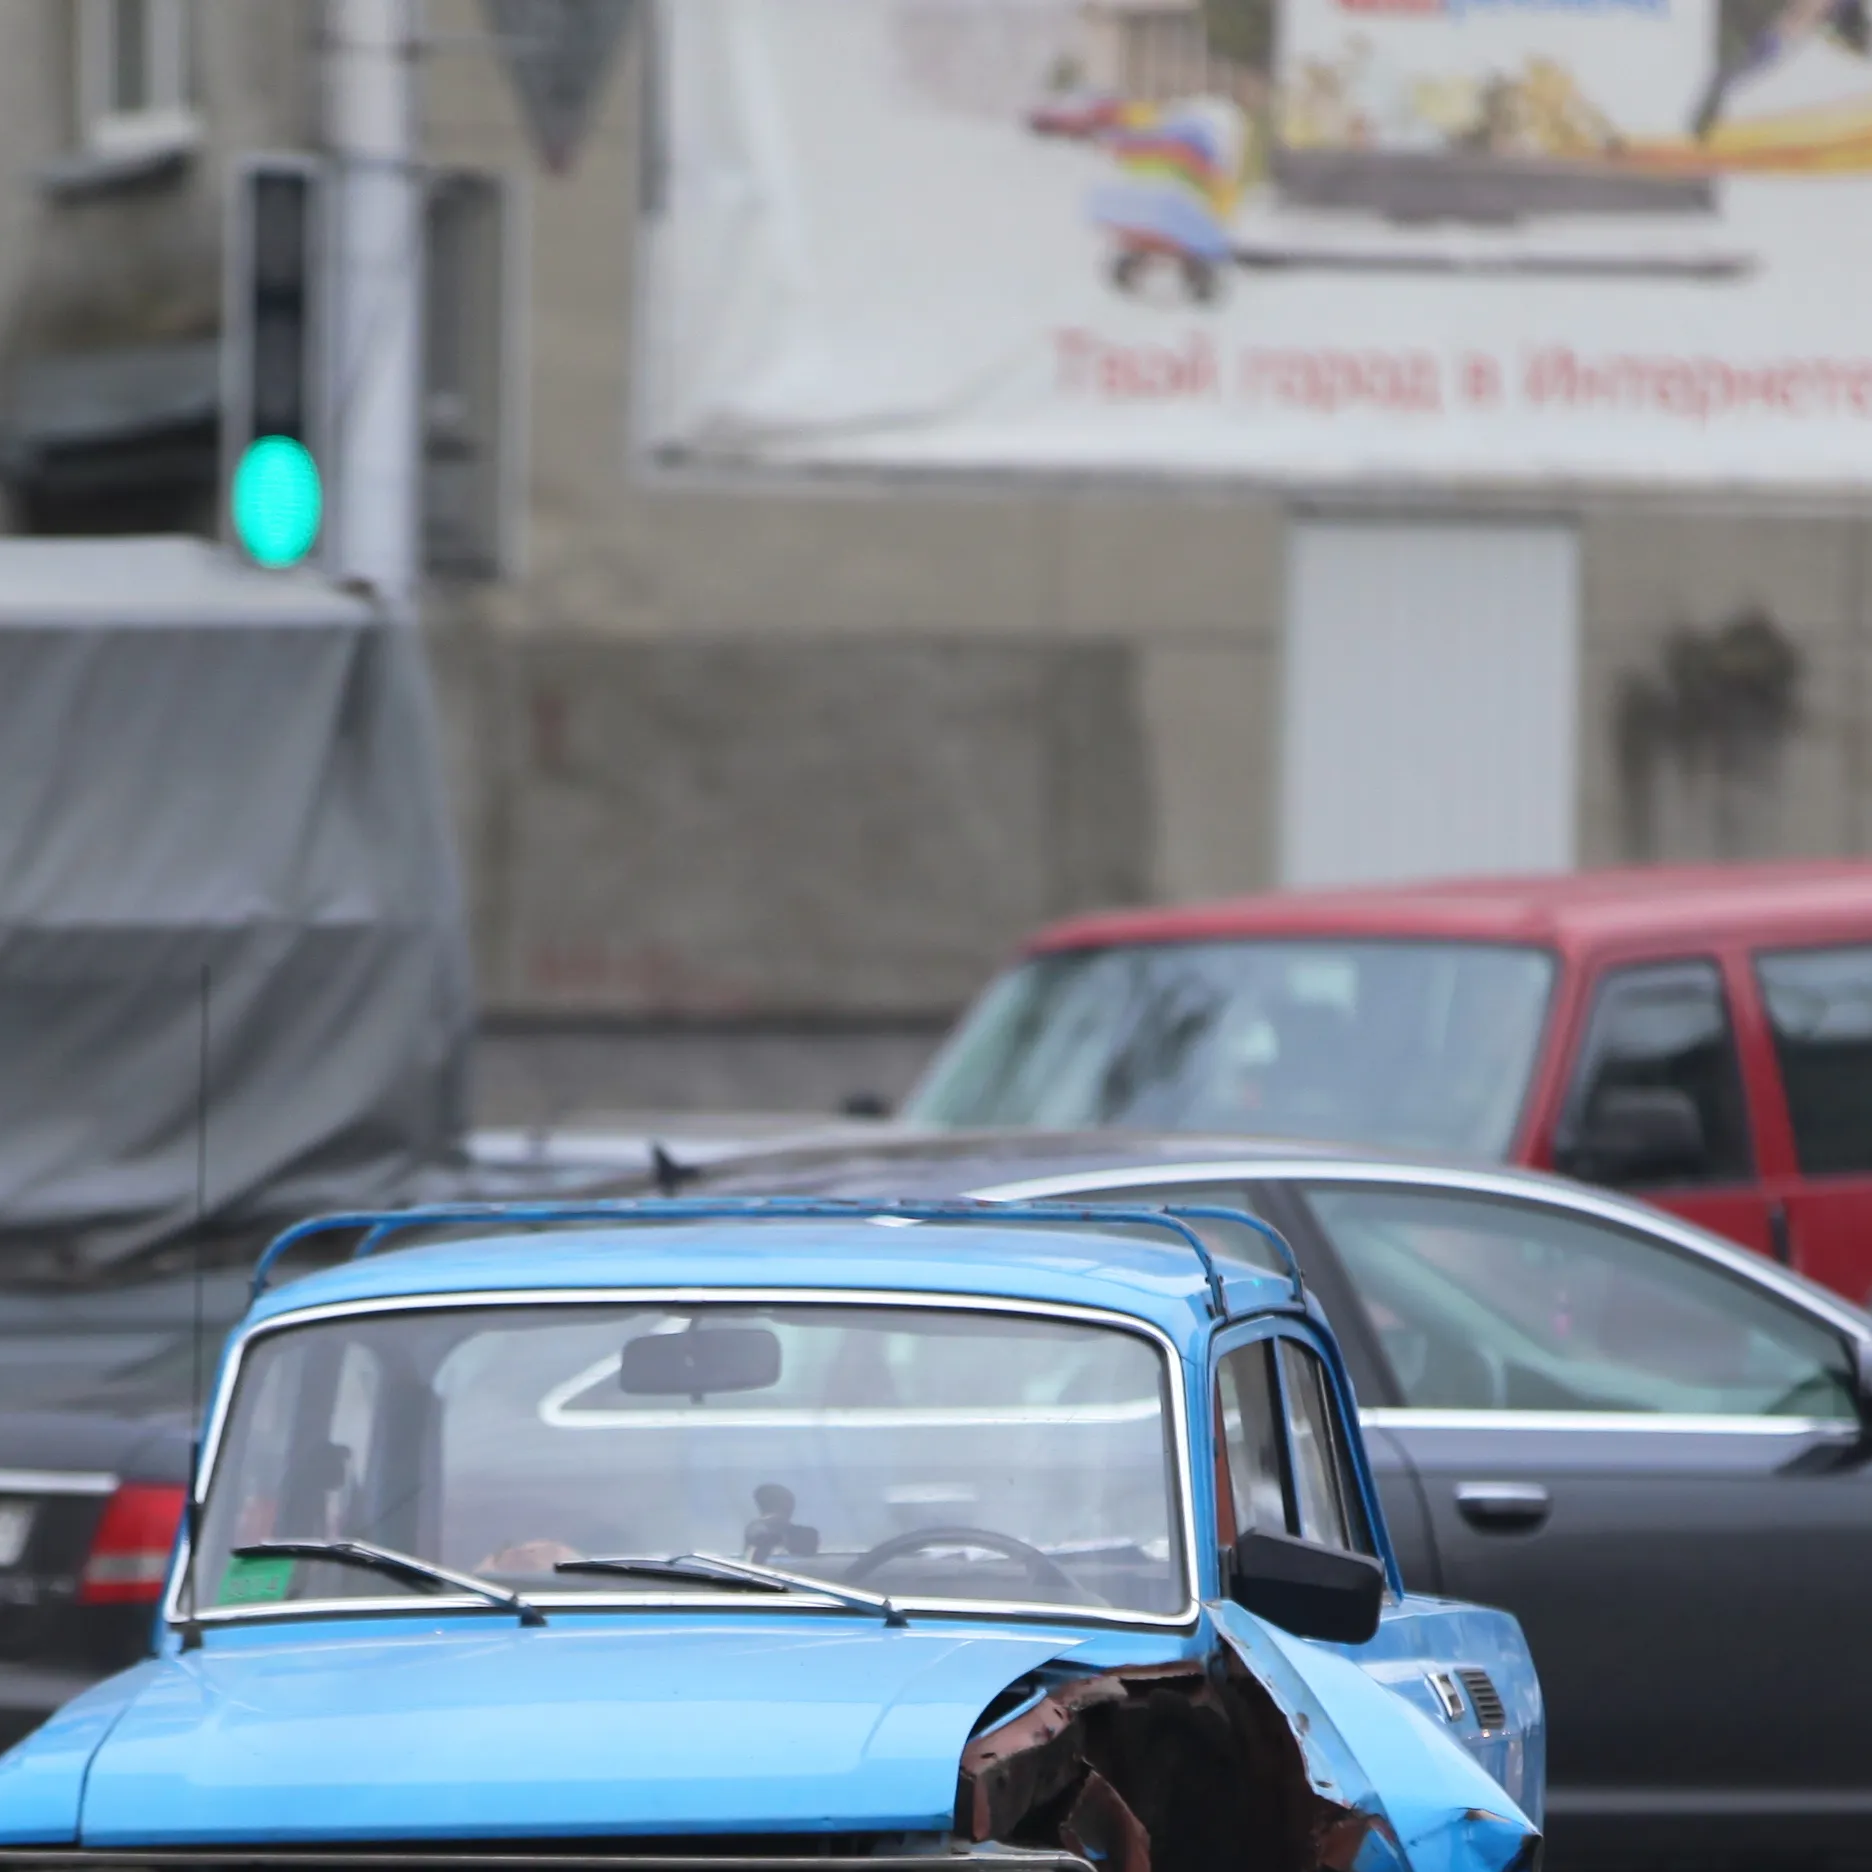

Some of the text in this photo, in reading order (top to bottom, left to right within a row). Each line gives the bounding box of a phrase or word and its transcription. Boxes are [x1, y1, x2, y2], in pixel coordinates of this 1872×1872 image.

[1056, 328, 1213, 400] Твой
[1240, 348, 1438, 412] город
[1457, 354, 1498, 408] в
